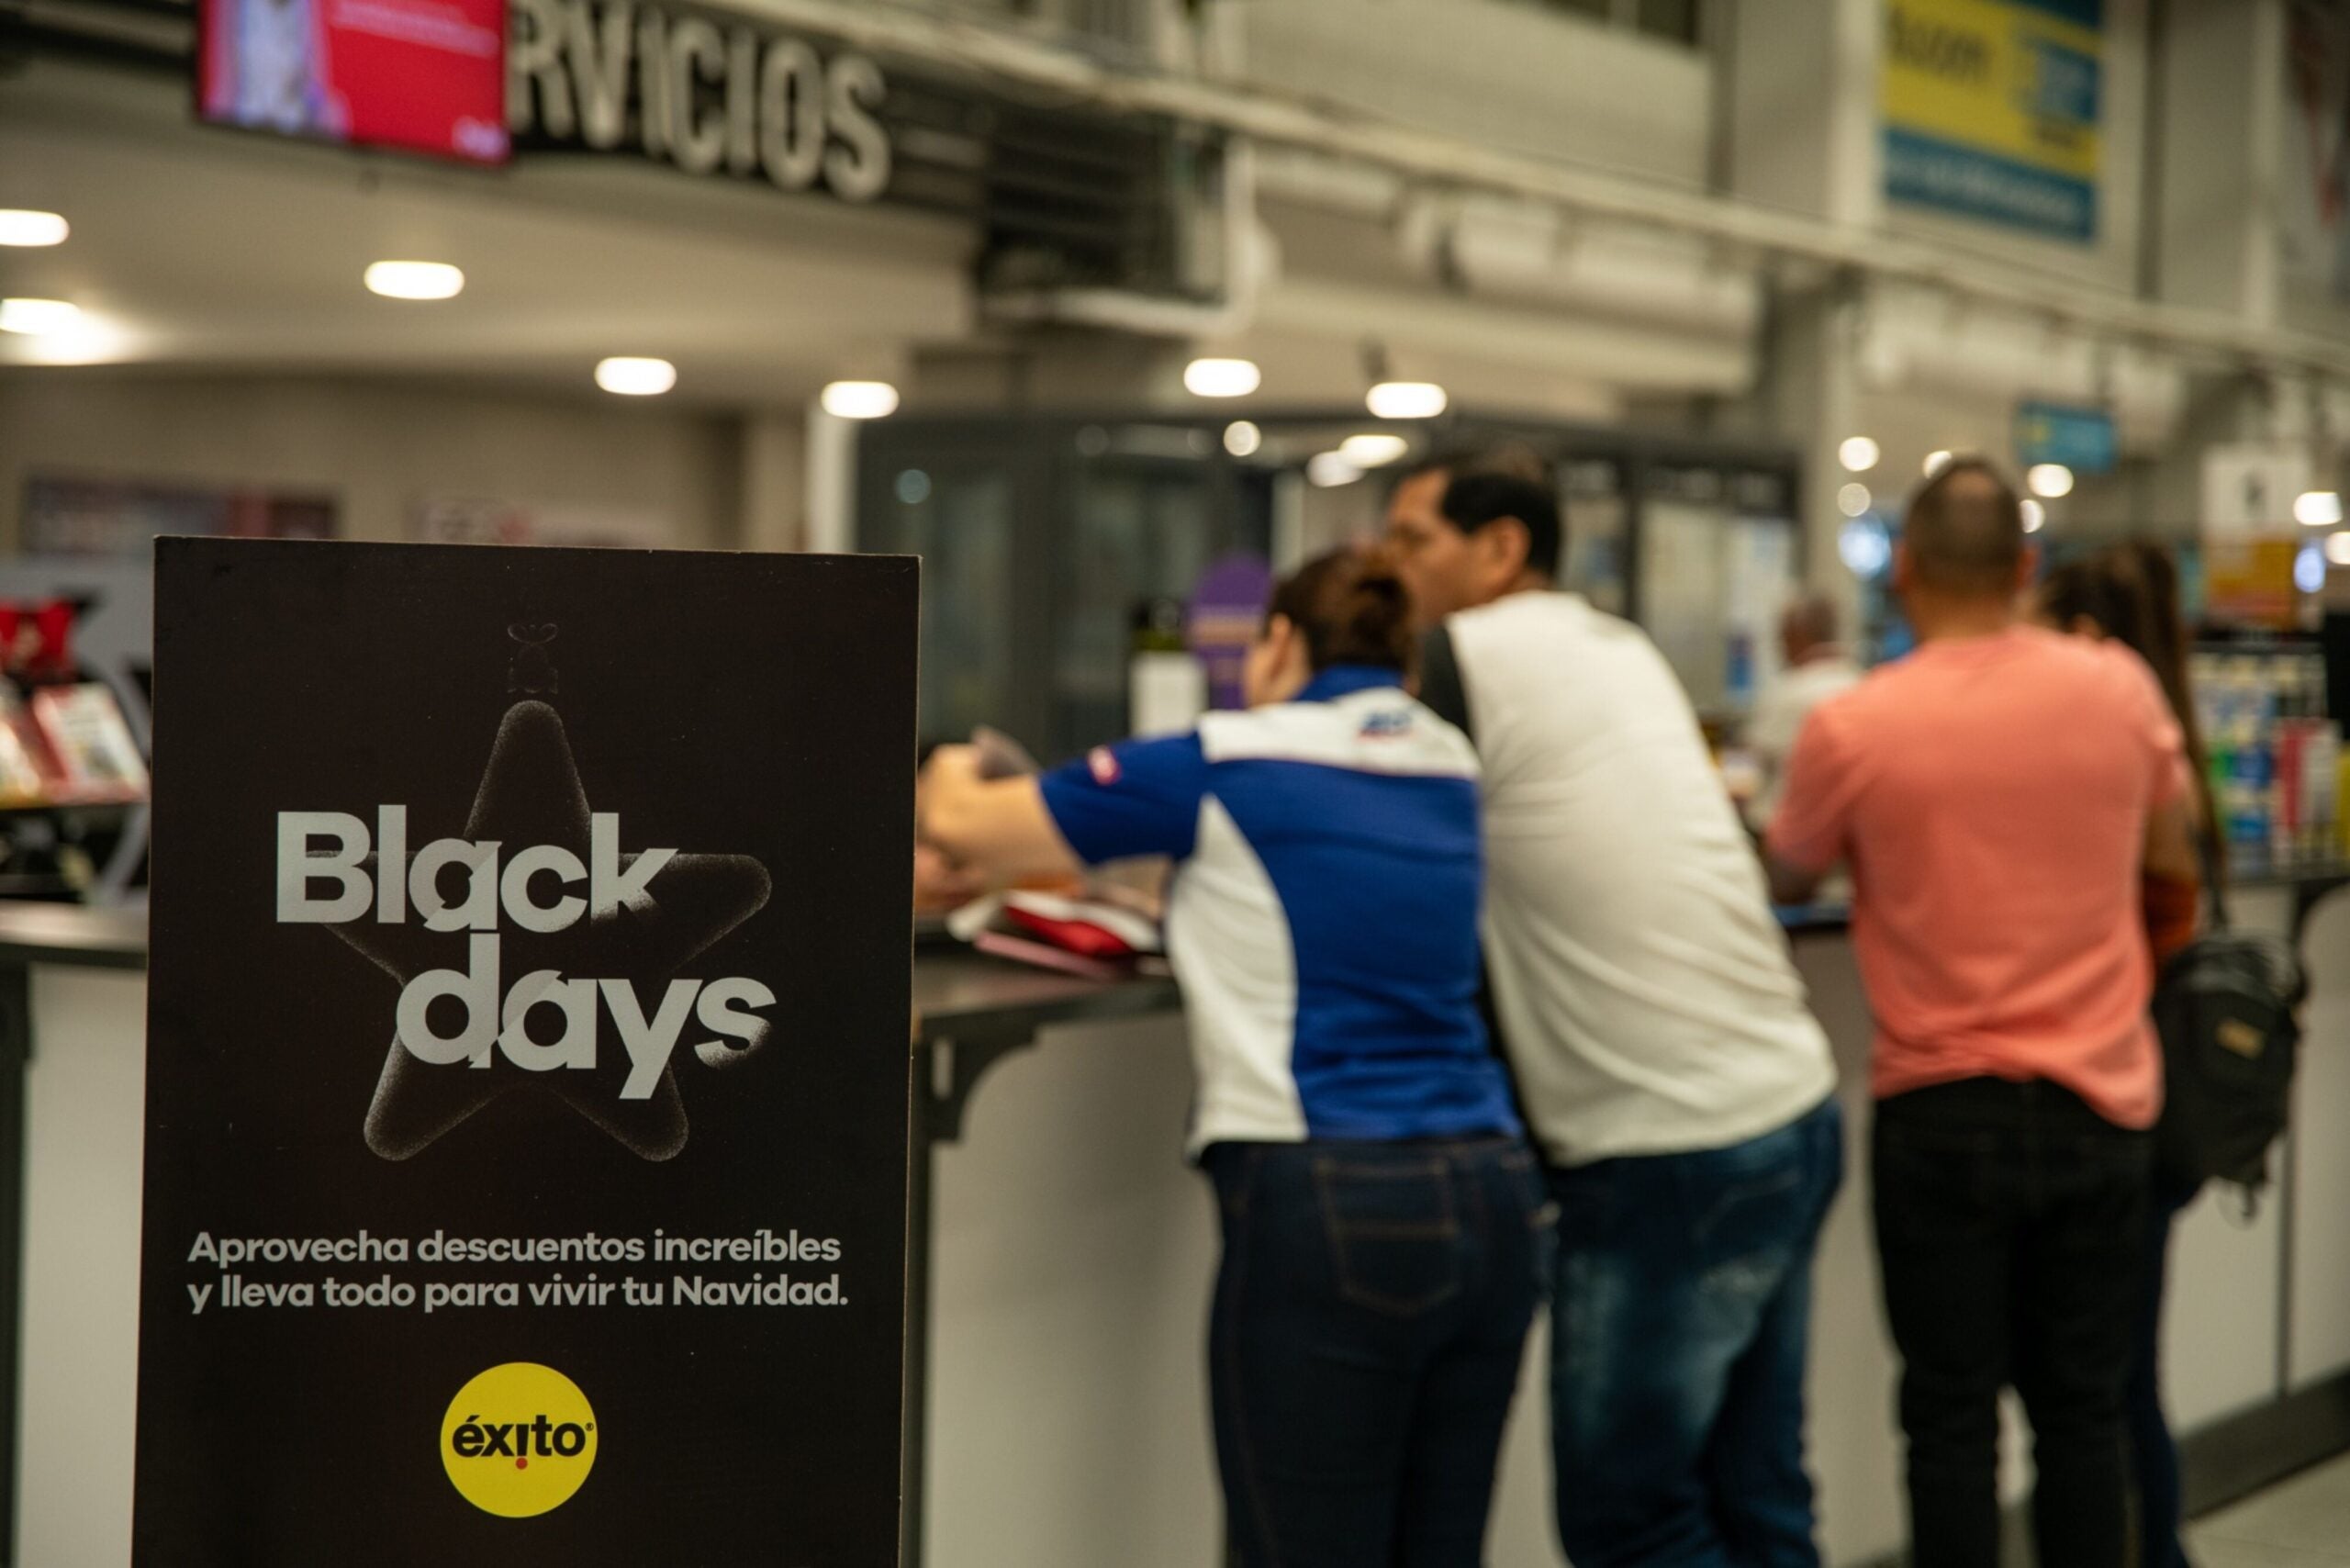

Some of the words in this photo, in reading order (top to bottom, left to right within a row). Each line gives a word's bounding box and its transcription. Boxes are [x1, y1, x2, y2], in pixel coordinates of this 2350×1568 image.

[276, 804, 679, 934] Black
[397, 933, 777, 1100] days
[187, 1230, 409, 1270] Aprovecha
[417, 1229, 645, 1262] descuentos
[654, 1228, 842, 1262] increíbles
[187, 1283, 213, 1315] y
[220, 1274, 314, 1307] lleva
[321, 1273, 416, 1307] todo
[424, 1282, 519, 1314] para
[528, 1272, 616, 1306] vivir
[621, 1276, 664, 1306] tu
[673, 1273, 849, 1306] Navidad.
